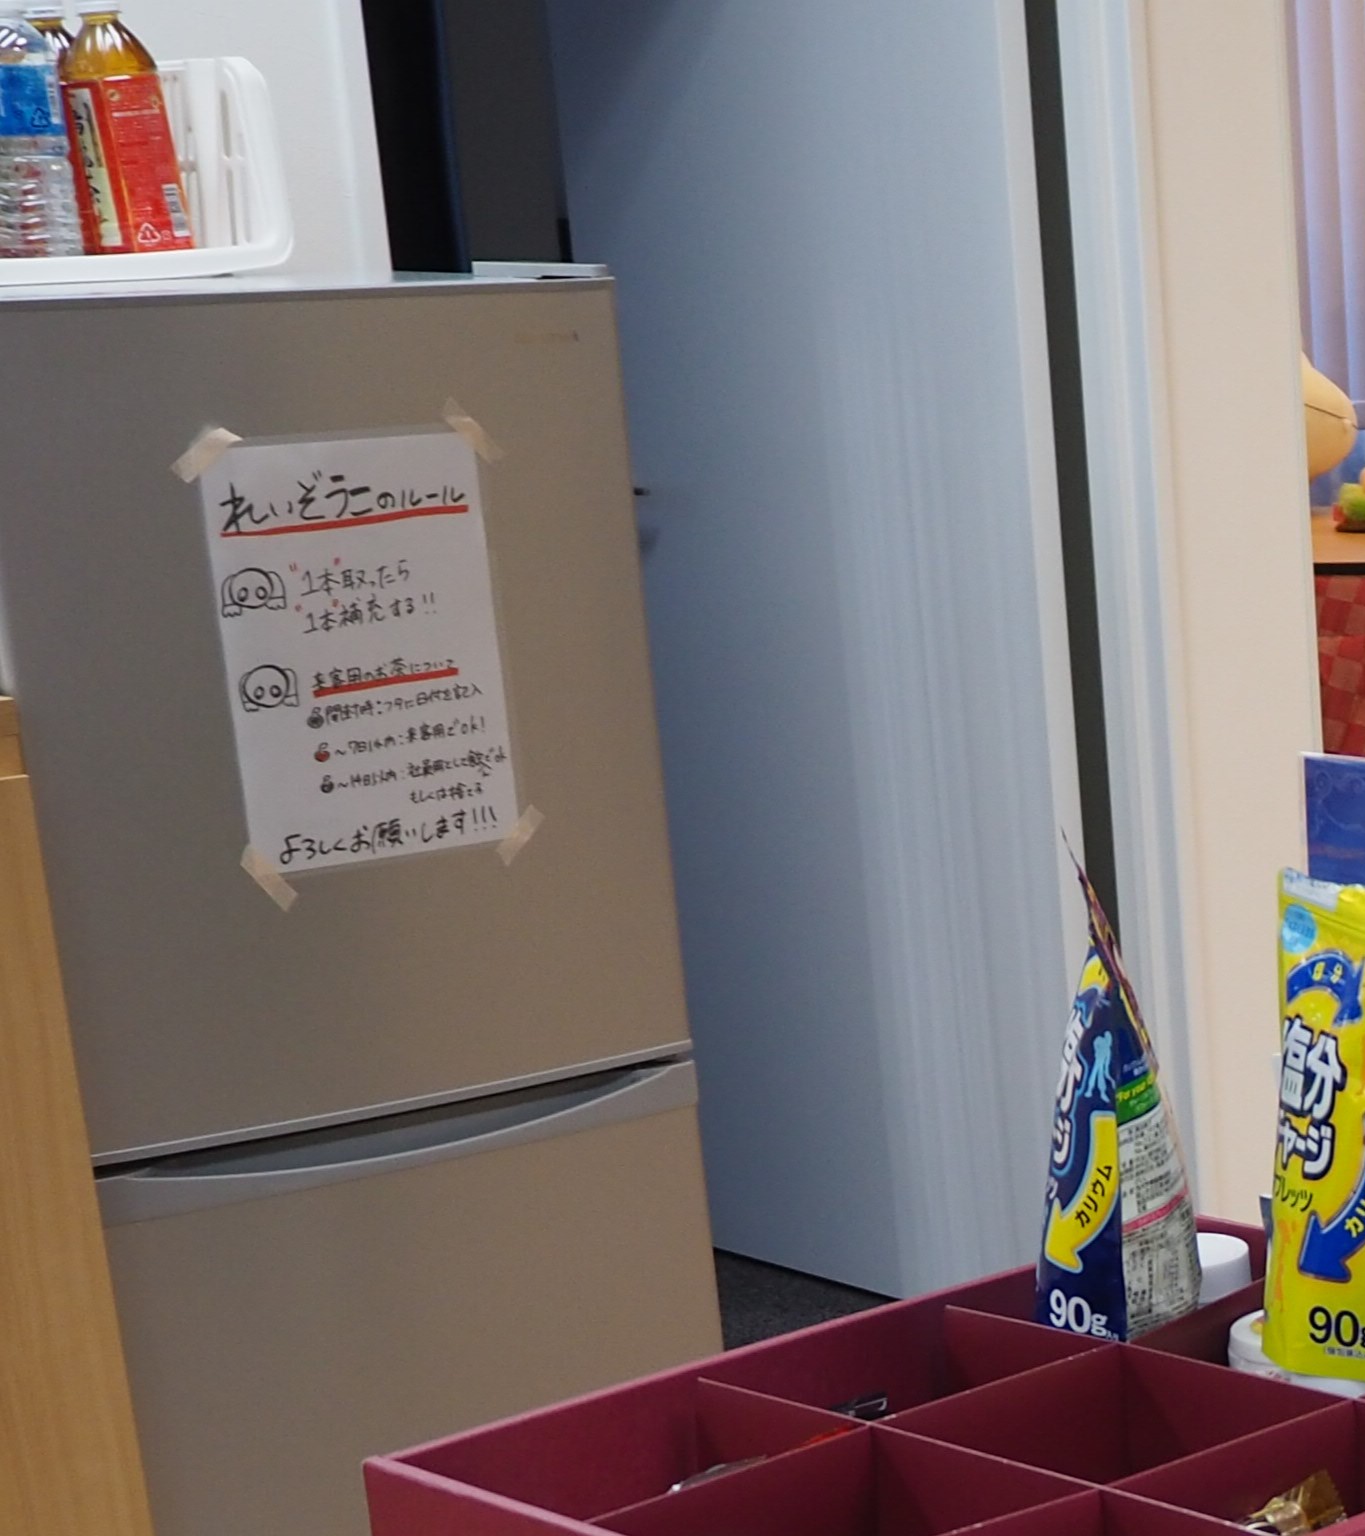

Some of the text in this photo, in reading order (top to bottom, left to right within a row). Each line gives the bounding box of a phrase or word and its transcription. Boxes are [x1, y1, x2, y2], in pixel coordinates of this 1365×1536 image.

[220, 470, 466, 532] れいぞうこのルール
[1075, 1163, 1114, 1230] カリウム
[1049, 1288, 1108, 1338] 90g
